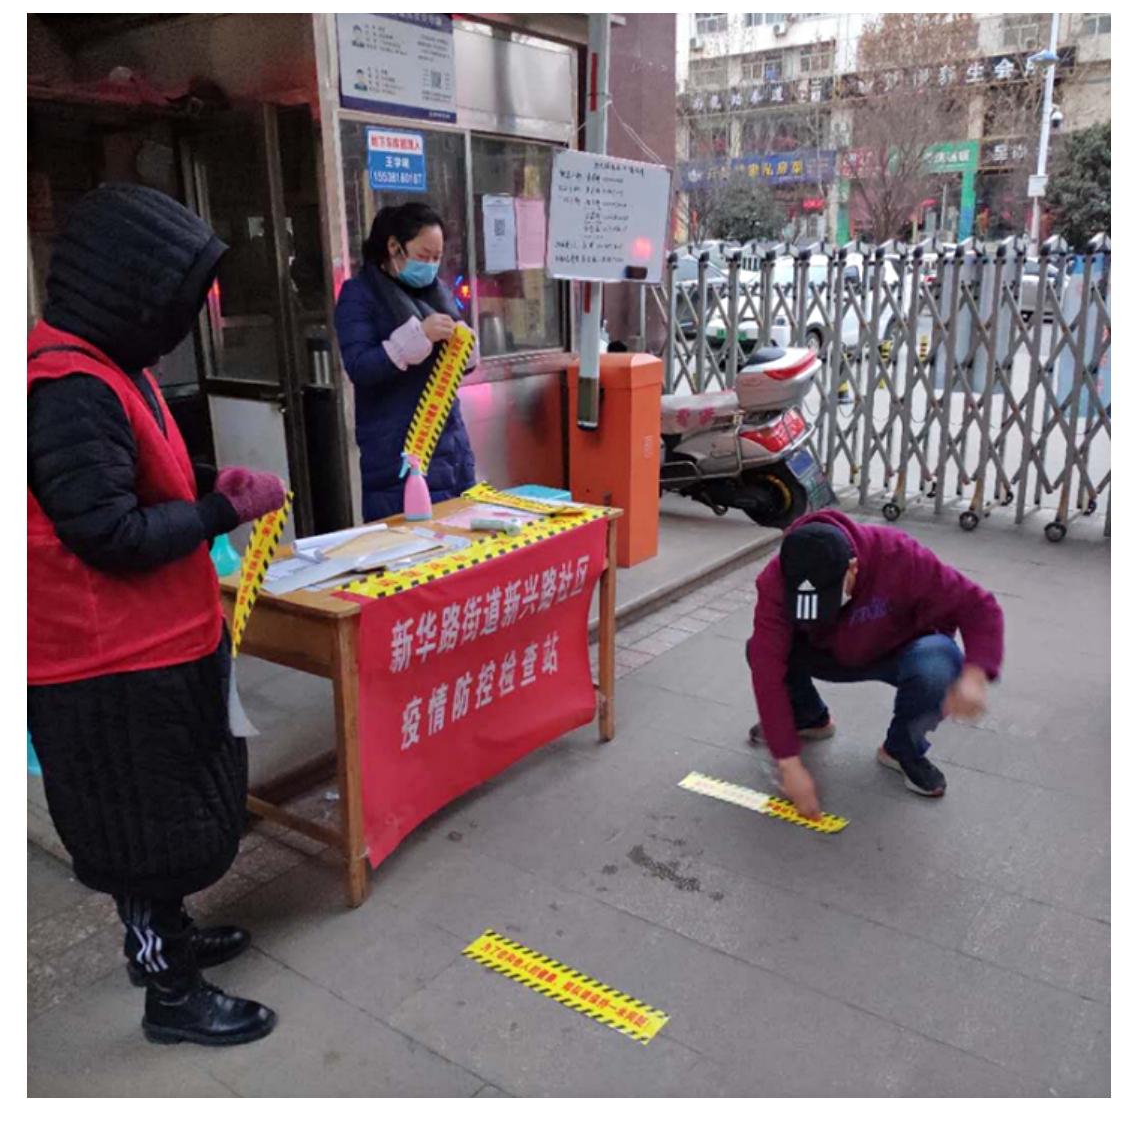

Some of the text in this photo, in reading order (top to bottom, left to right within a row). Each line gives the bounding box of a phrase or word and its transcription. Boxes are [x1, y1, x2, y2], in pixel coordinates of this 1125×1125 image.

[390, 556, 590, 673] 新华路街道新兴路社区
[401, 630, 559, 750] 疫情防控检查站
